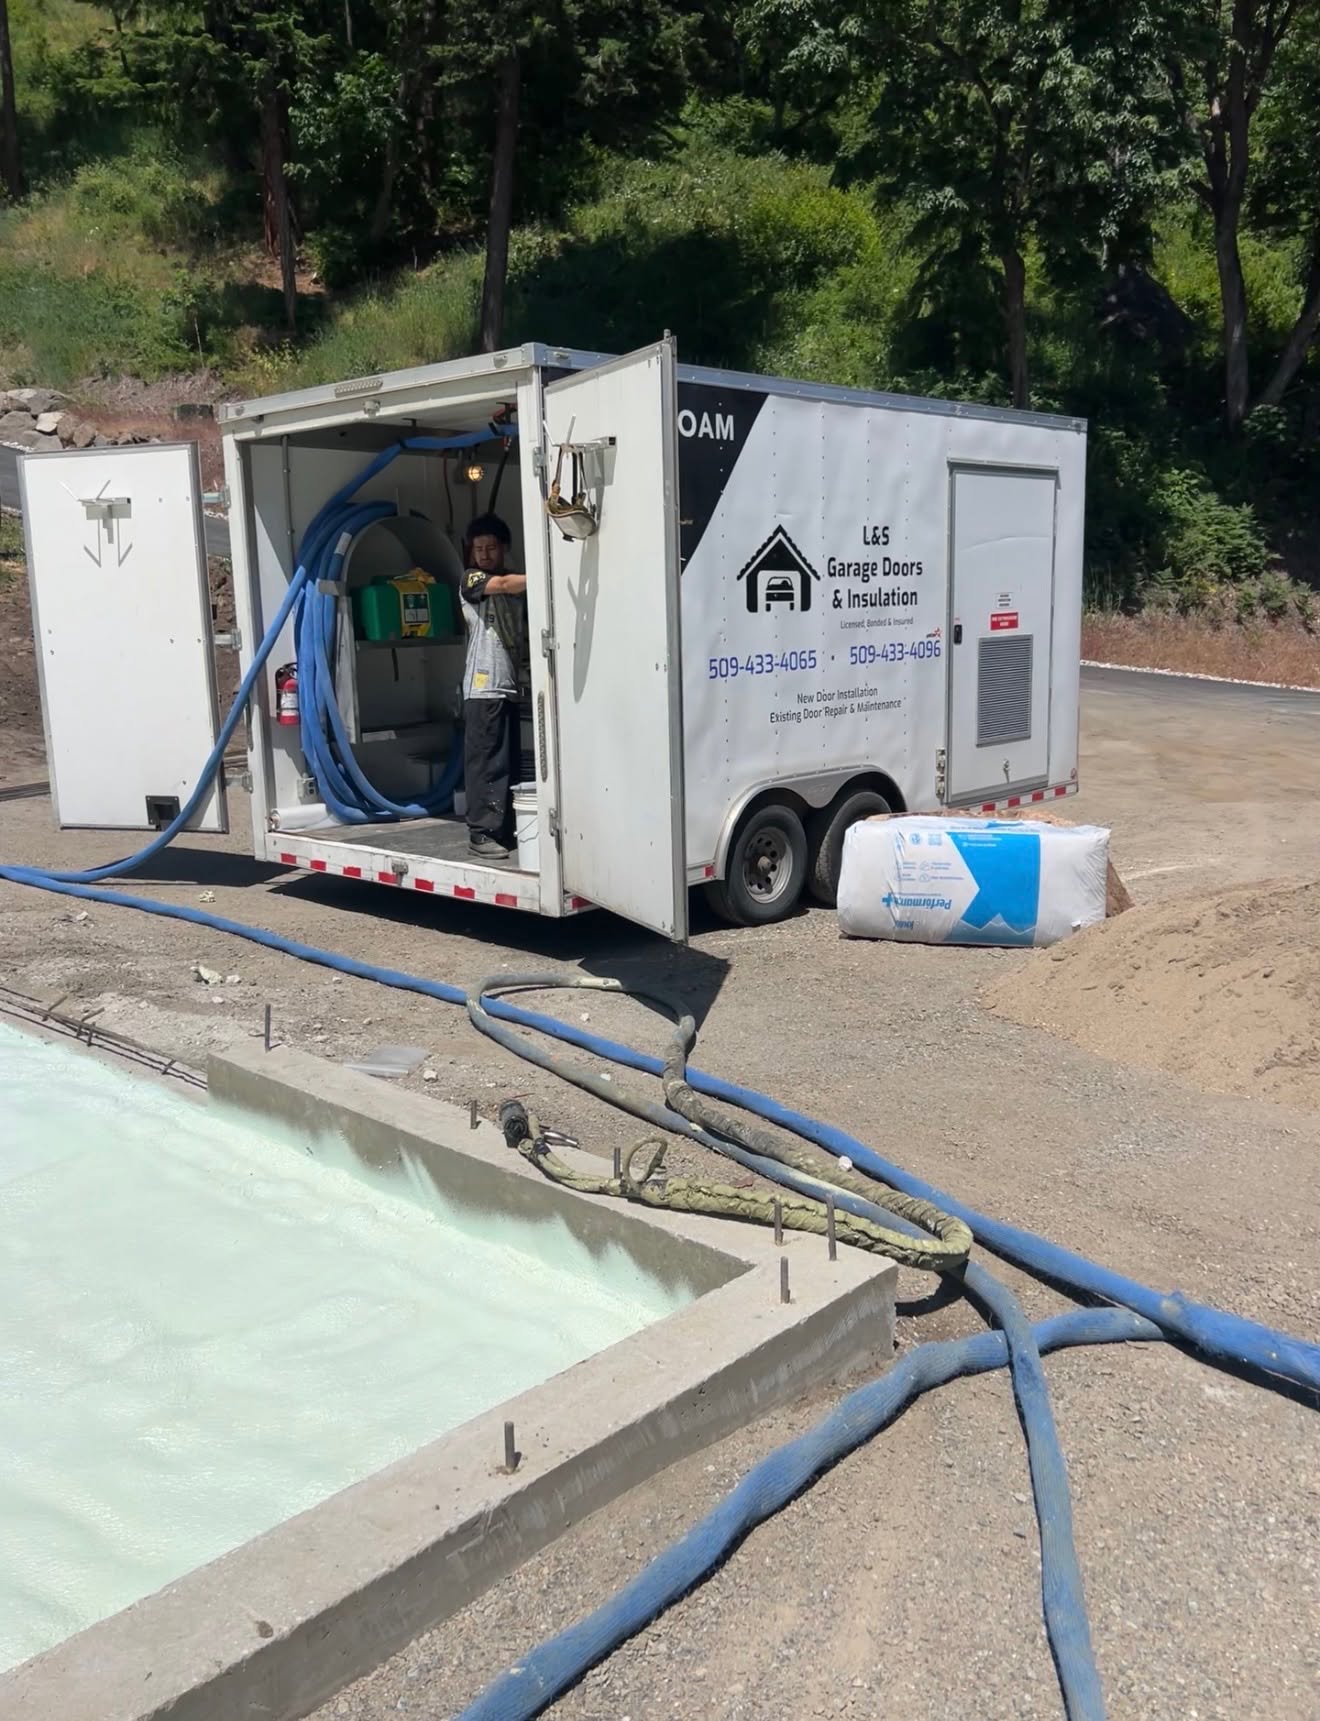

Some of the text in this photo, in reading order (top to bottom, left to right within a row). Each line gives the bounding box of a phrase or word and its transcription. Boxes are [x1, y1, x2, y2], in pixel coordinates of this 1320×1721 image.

[678, 409, 735, 441] OAM
[863, 525, 890, 546] L&S
[827, 557, 923, 583] Garage Doors
[832, 587, 918, 609] & Insulation
[867, 618, 887, 628] Bonded
[888, 618, 892, 626] &
[893, 617, 914, 626] Insured
[708, 640, 941, 679] 509-433-4065 509-433-4096
[797, 687, 878, 704] New Door Installation
[770, 699, 902, 723] Existing Door Repair & Maintenance
